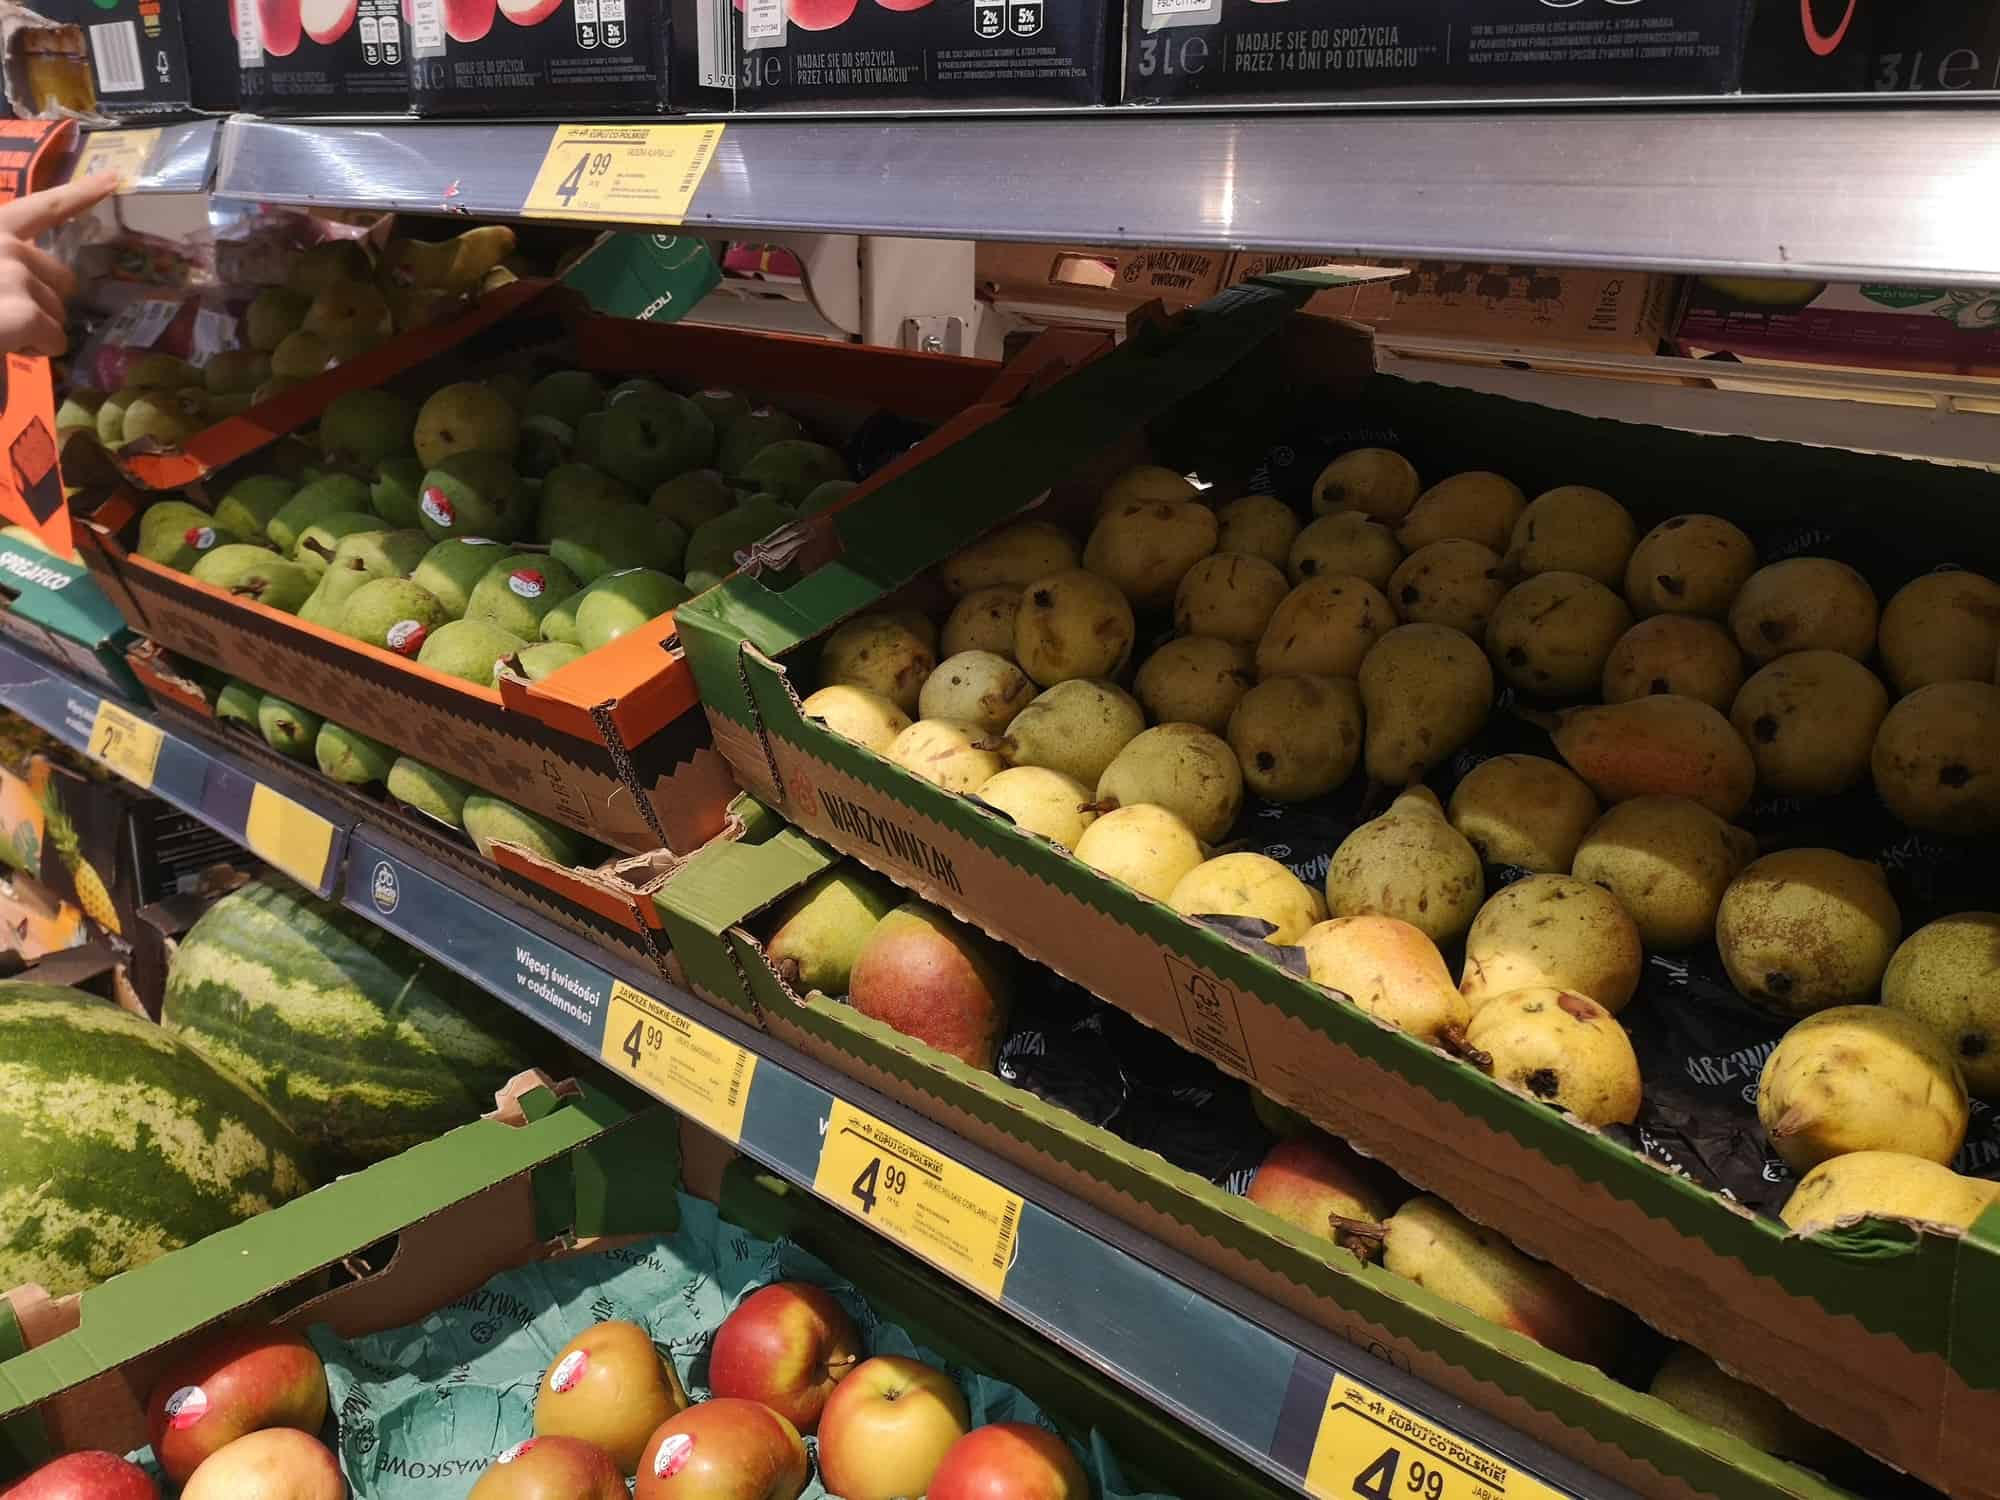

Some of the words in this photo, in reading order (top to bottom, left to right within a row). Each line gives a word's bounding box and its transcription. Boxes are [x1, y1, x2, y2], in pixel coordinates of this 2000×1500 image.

[983, 9, 998, 25] 2%
[1019, 8, 1035, 23] 5%
[1236, 31, 1282, 51] NADAJE
[1311, 29, 1330, 49] DO
[1333, 25, 1399, 48] SPOŻYCIA
[797, 53, 826, 69] NADAJE
[841, 52, 853, 68] DO
[855, 49, 896, 68] SPOŻYCIA
[797, 69, 822, 85] PRZEZ
[823, 69, 834, 84] 14
[835, 68, 850, 84] DNI
[852, 68, 863, 84] PO
[1235, 51, 1273, 73] PRZEZ
[1279, 51, 1295, 71] 14
[1299, 50, 1321, 71] DNI
[1325, 49, 1343, 69] PO
[556, 152, 591, 208] 4
[589, 152, 612, 176] 99
[818, 787, 964, 896] WARZYWNIAK
[516, 946, 551, 981] Więcej
[551, 967, 601, 1008] świeżości
[516, 972, 527, 985] w
[527, 979, 592, 1026] codzienności
[618, 986, 649, 1009] ZAWSZE
[648, 999, 672, 1022] NISKIE
[671, 1013, 691, 1032] CENY
[622, 1018, 645, 1069] 4
[645, 1025, 663, 1051] 99
[850, 1156, 882, 1215] 4
[883, 1164, 907, 1195] 99
[1352, 1447, 1401, 1500] 4
[1406, 1460, 1444, 1500] 99
[1387, 1414, 1427, 1441] KUPUJ
[1428, 1437, 1447, 1452] CO
[1448, 1447, 1506, 1485] POLSKIE!
